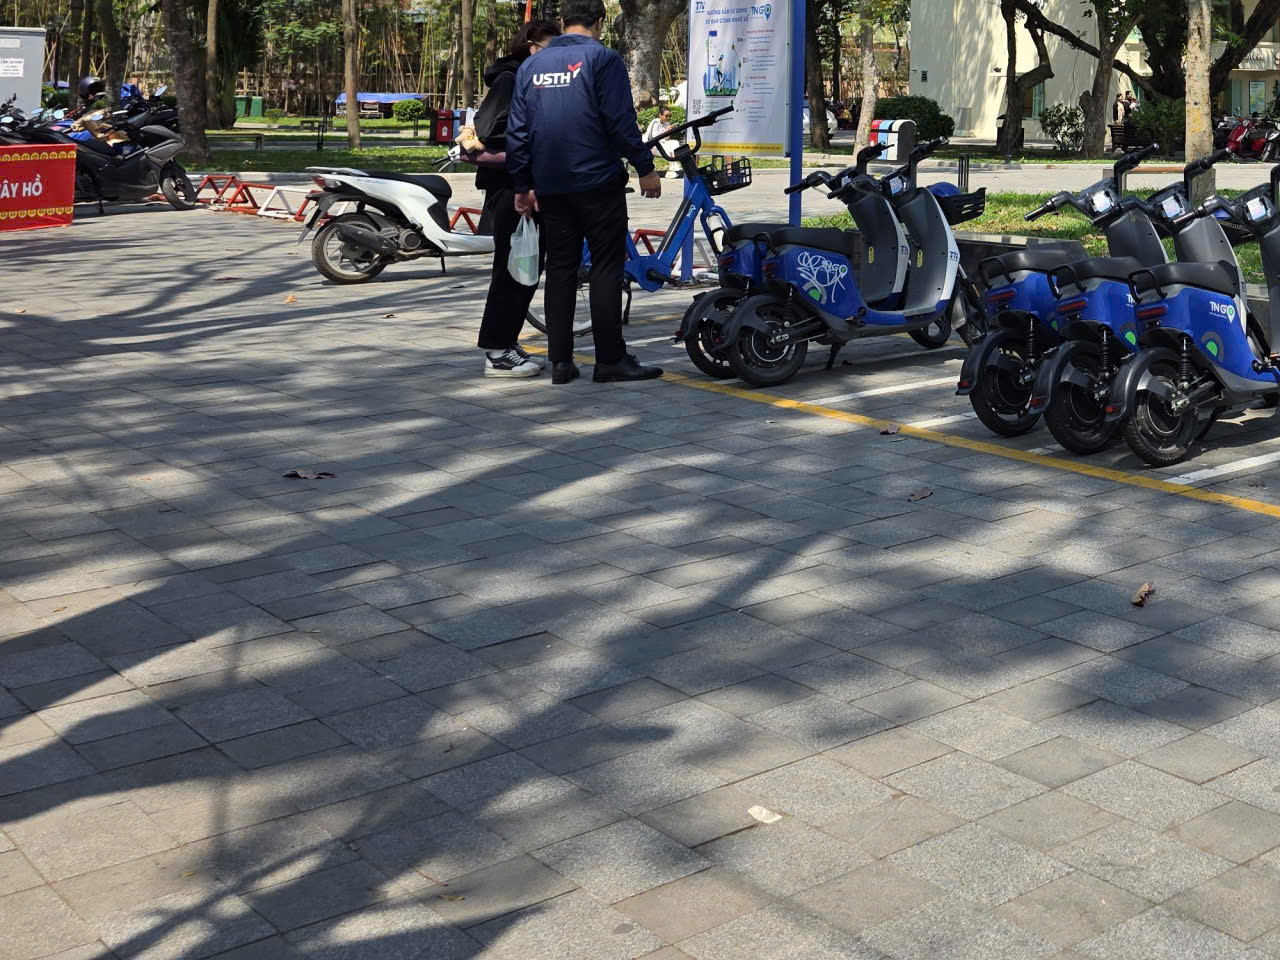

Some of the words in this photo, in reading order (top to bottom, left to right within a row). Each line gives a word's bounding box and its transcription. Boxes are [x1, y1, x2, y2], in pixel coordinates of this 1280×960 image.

[532, 71, 571, 86] USTH
[0, 179, 19, 199] ÂY
[22, 173, 43, 197] HỒ
